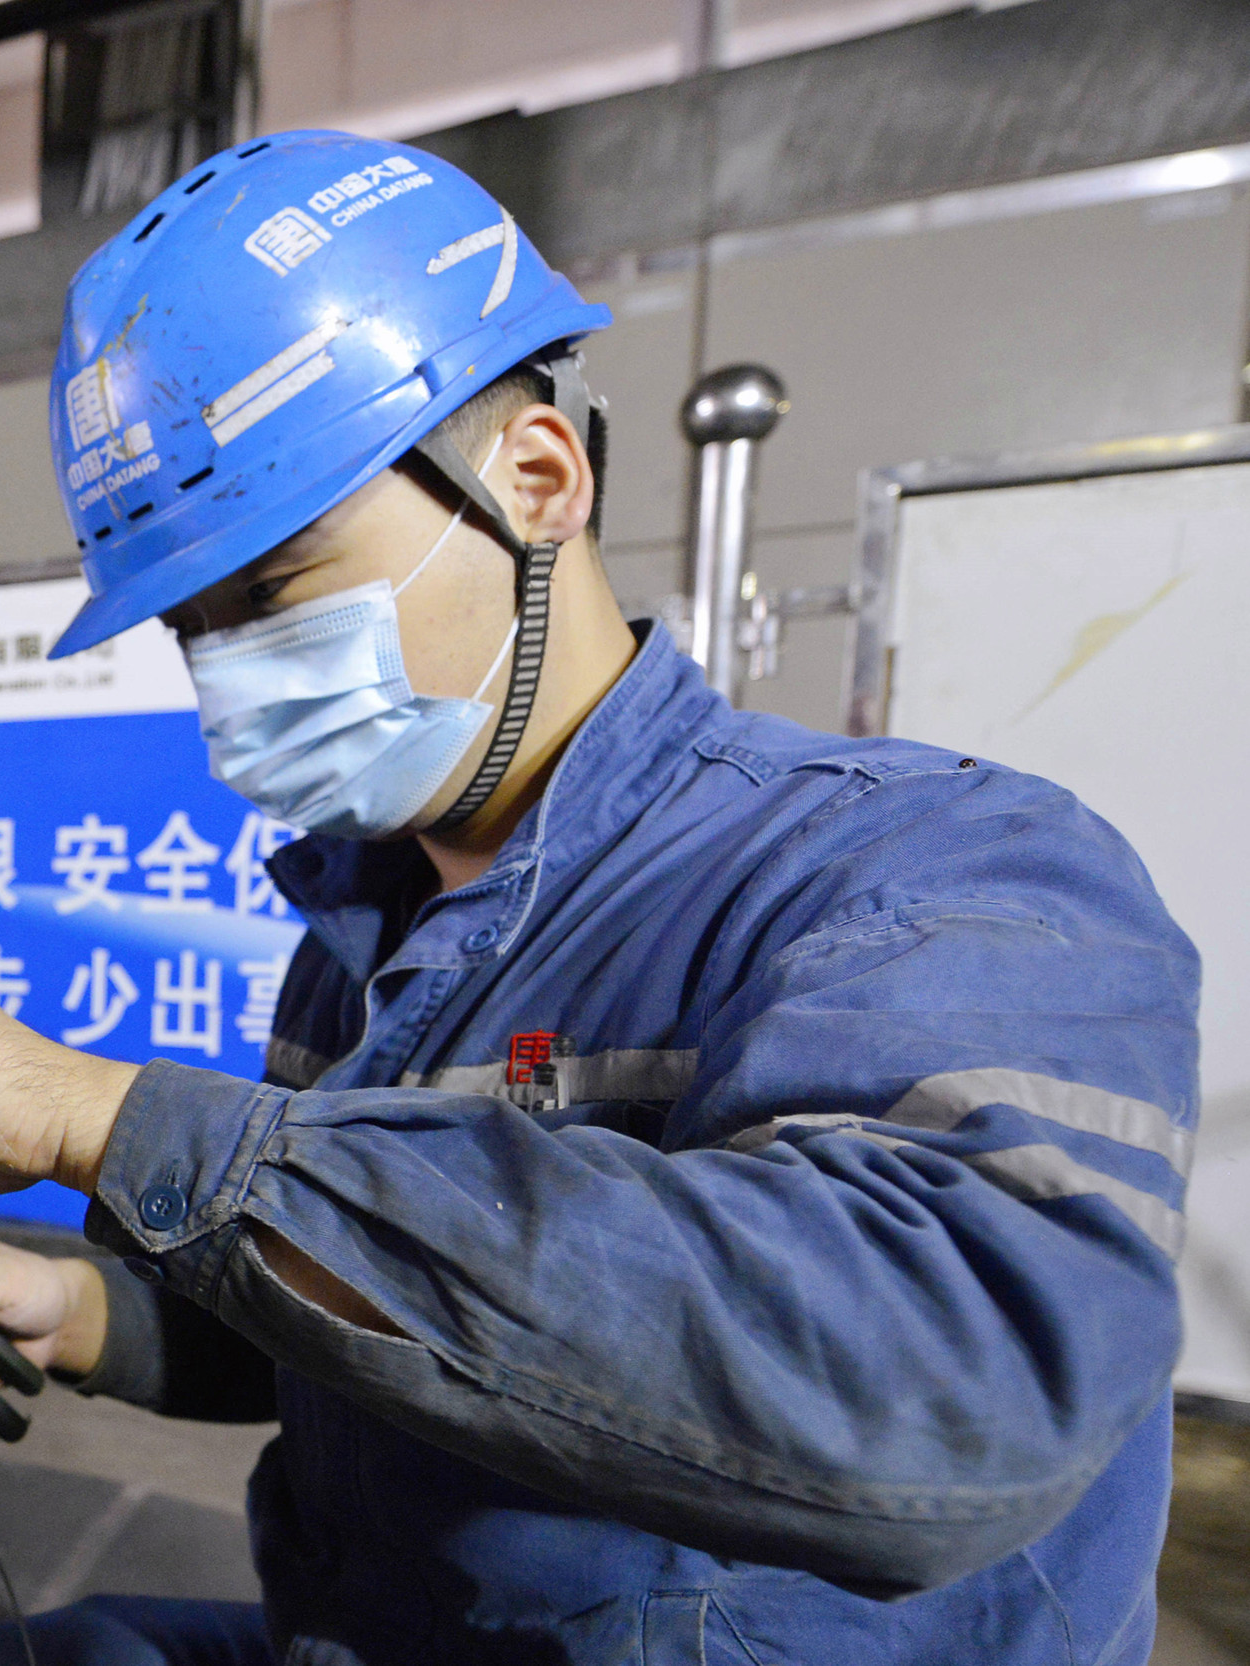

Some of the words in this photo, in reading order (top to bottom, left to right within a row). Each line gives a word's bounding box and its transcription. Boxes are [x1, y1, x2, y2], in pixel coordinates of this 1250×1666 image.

[307, 155, 419, 214] 中国大唐
[330, 194, 384, 227] CHINA
[377, 172, 434, 201] DATANG
